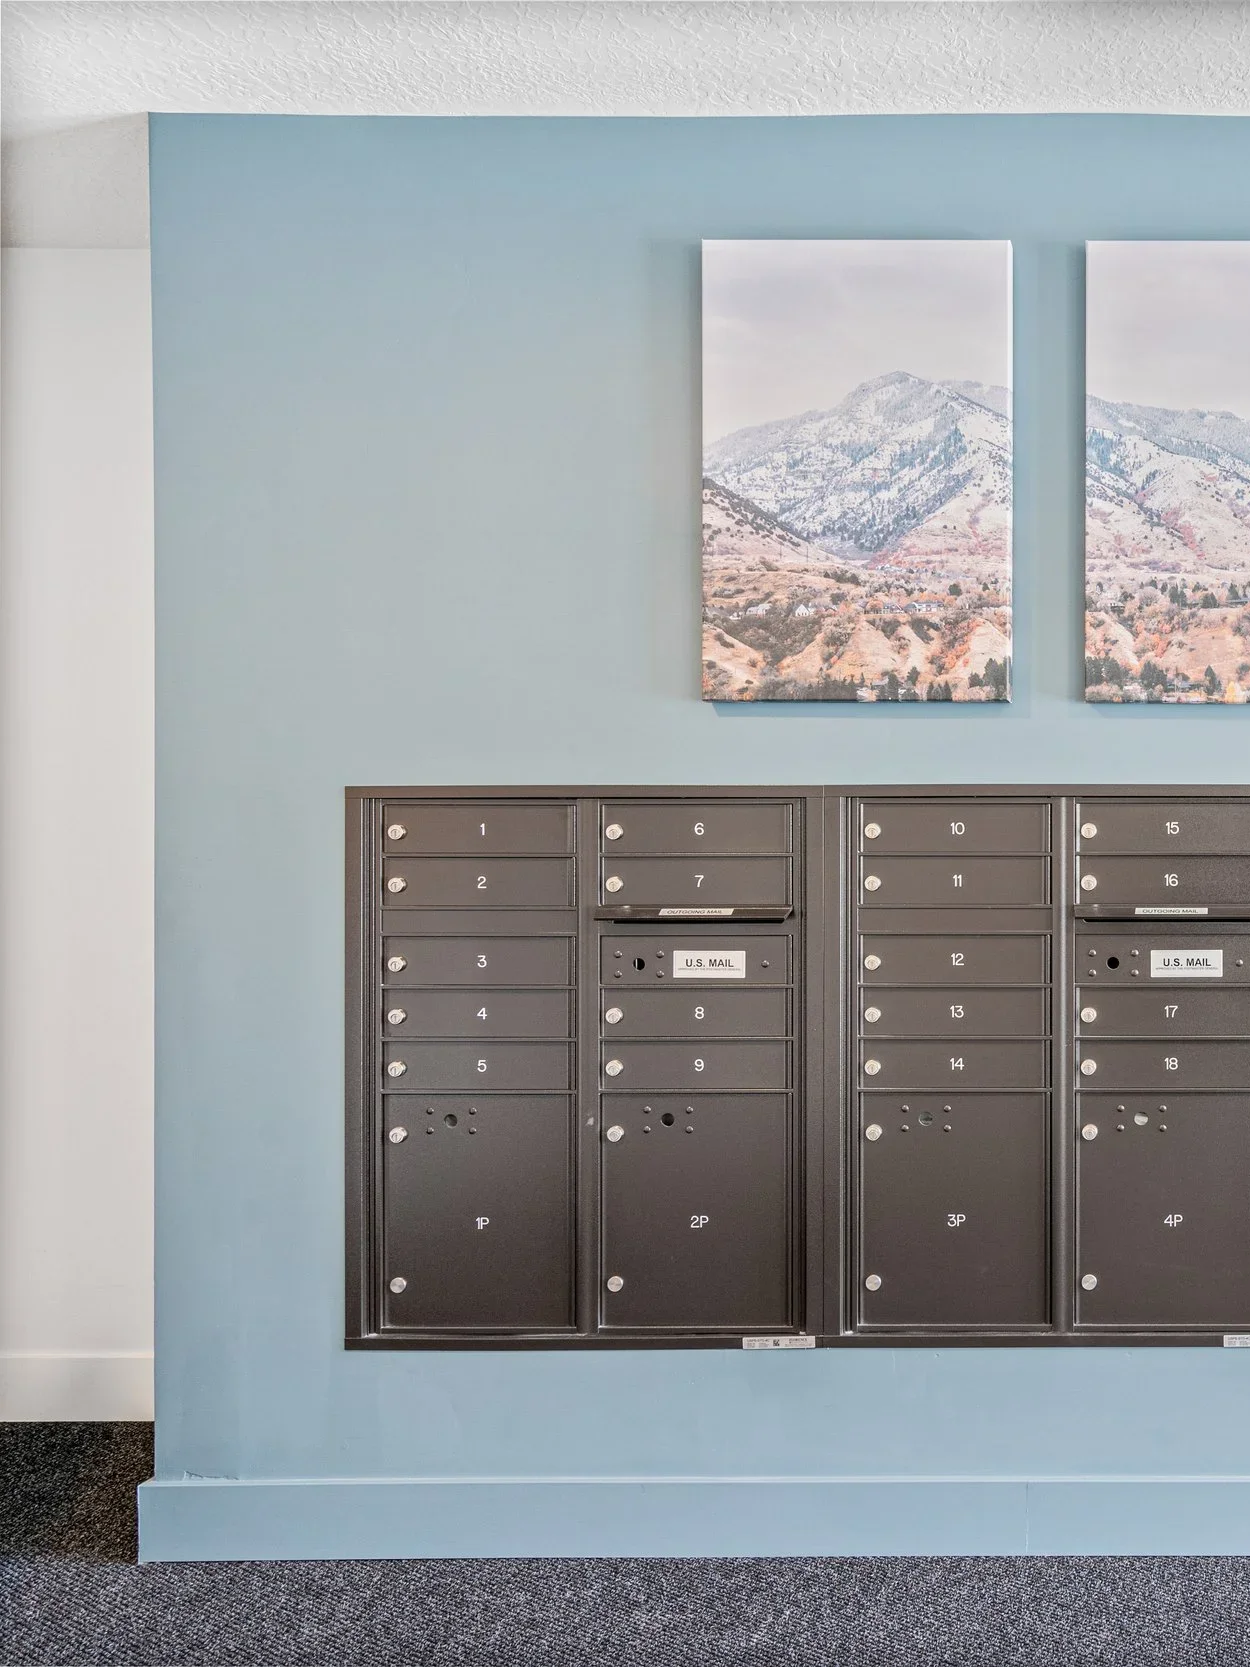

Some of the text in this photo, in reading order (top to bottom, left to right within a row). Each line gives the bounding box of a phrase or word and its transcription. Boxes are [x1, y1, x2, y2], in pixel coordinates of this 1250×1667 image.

[480, 823, 485, 836] 1
[694, 822, 705, 836] 6
[950, 822, 966, 835] 10
[1165, 821, 1180, 835] 15
[477, 875, 487, 889] 2
[694, 874, 705, 888] 7
[952, 874, 962, 888] 11
[1164, 873, 1179, 887] 16
[477, 954, 487, 968] 3
[685, 958, 734, 968] U.S. MAIL
[950, 952, 965, 966] 12
[1162, 957, 1212, 967] U.S. MAIL
[476, 1007, 488, 1020] 4
[694, 1006, 705, 1020] 8
[949, 1005, 964, 1019] 13
[1164, 1005, 1179, 1018] 17
[477, 1059, 487, 1073] 5
[694, 1058, 705, 1072] 9
[949, 1057, 965, 1071] 14
[1164, 1057, 1179, 1071] 18
[475, 1216, 490, 1230] 1P
[690, 1215, 709, 1229] 2P
[947, 1214, 966, 1227] 3P
[1163, 1214, 1184, 1227] 4P
